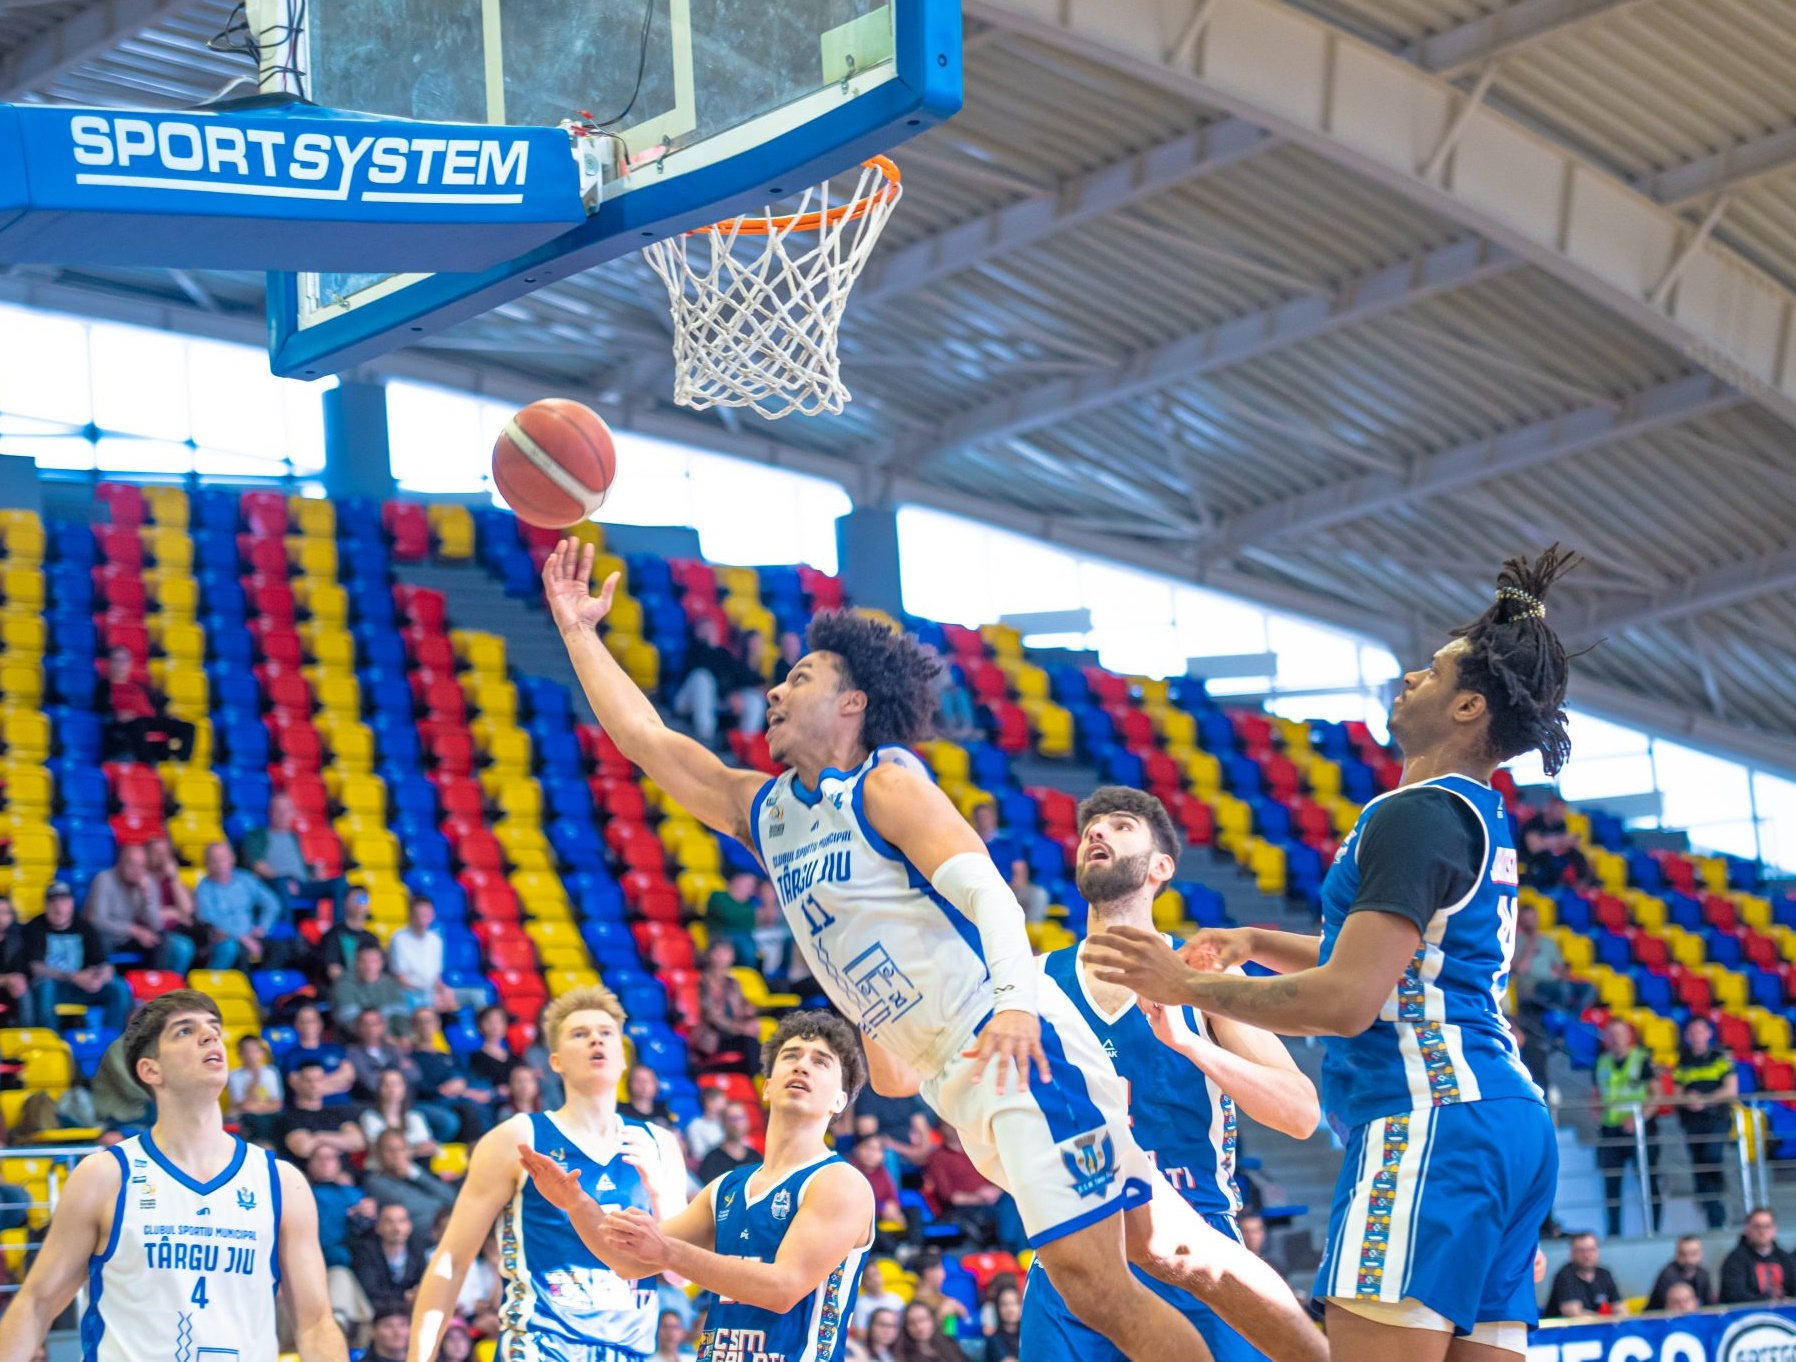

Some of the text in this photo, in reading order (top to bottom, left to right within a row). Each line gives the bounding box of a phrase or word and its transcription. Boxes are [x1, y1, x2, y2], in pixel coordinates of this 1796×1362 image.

[817, 850, 851, 884] JIU
[801, 893, 836, 936] 11
[143, 1225, 176, 1235] CLUBUL
[215, 1228, 257, 1241] MUNICIPAL
[143, 1236, 256, 1275] TÂRGU JIU
[190, 1276, 209, 1309] 4
